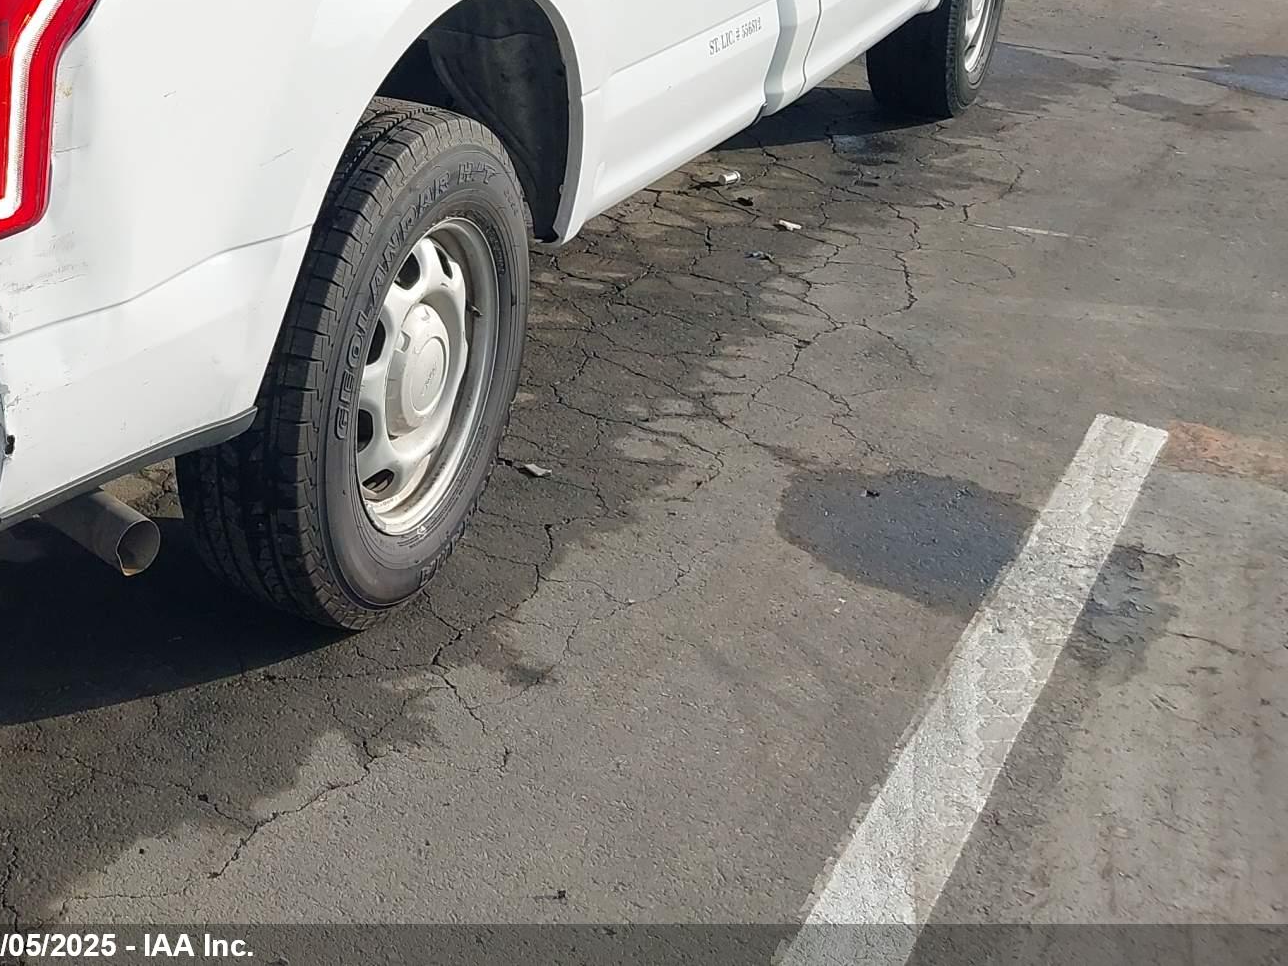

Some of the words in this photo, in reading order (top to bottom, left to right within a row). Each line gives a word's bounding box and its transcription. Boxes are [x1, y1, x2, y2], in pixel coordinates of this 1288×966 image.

[709, 37, 720, 55] ST.
[721, 30, 735, 50] LIC.
[335, 171, 450, 440] GEOLANDAR
